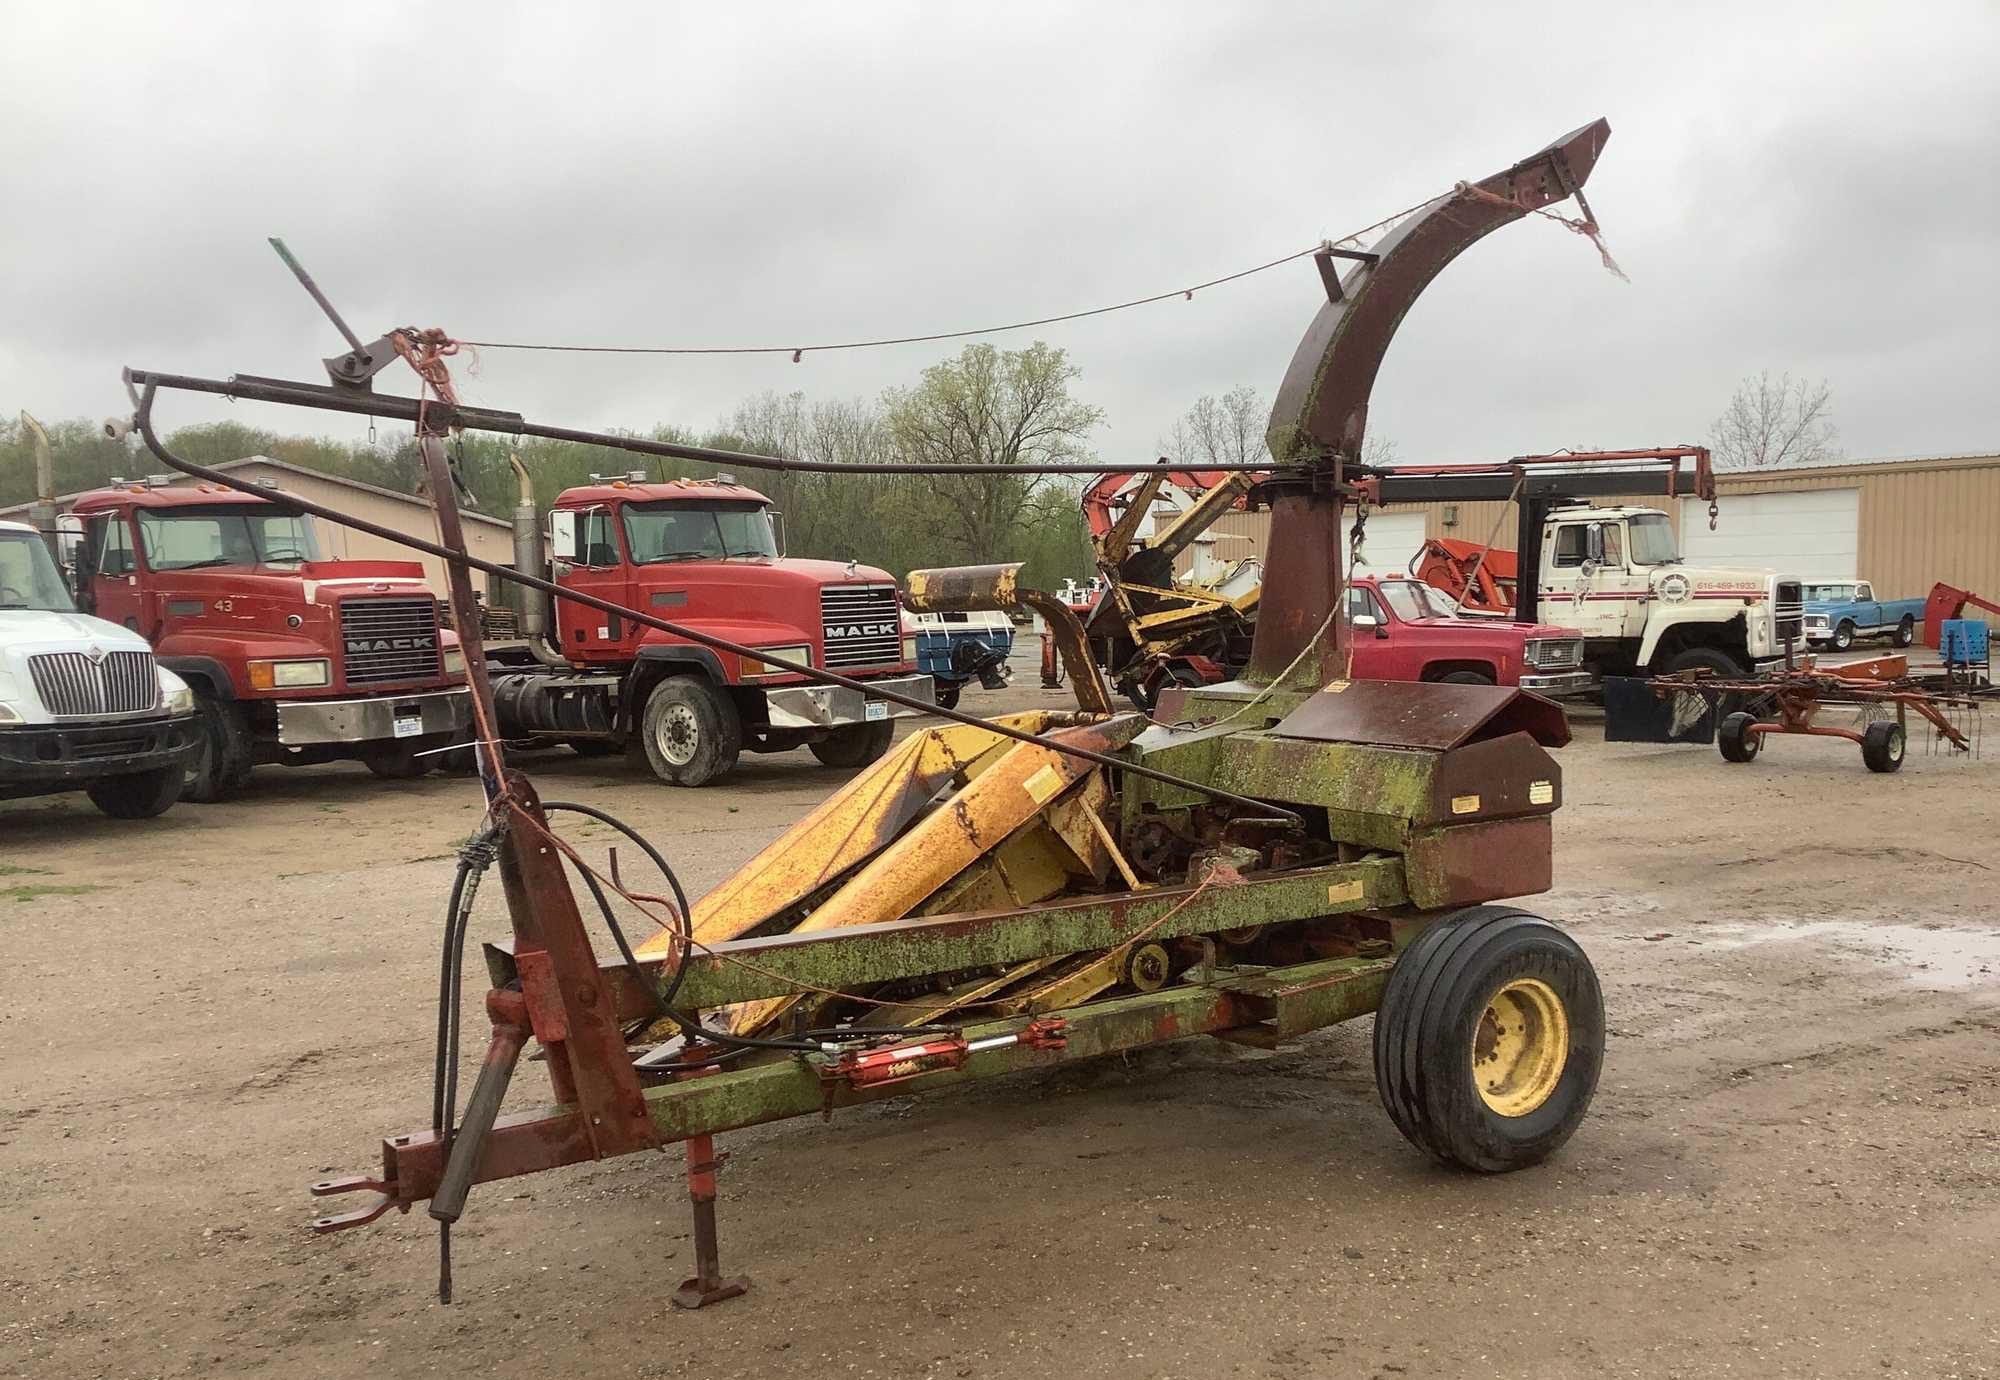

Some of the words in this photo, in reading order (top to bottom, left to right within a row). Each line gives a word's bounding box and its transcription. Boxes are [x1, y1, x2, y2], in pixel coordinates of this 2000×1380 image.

[214, 600, 233, 612] 43
[827, 624, 895, 638] MACK
[347, 638, 433, 653] MACK
